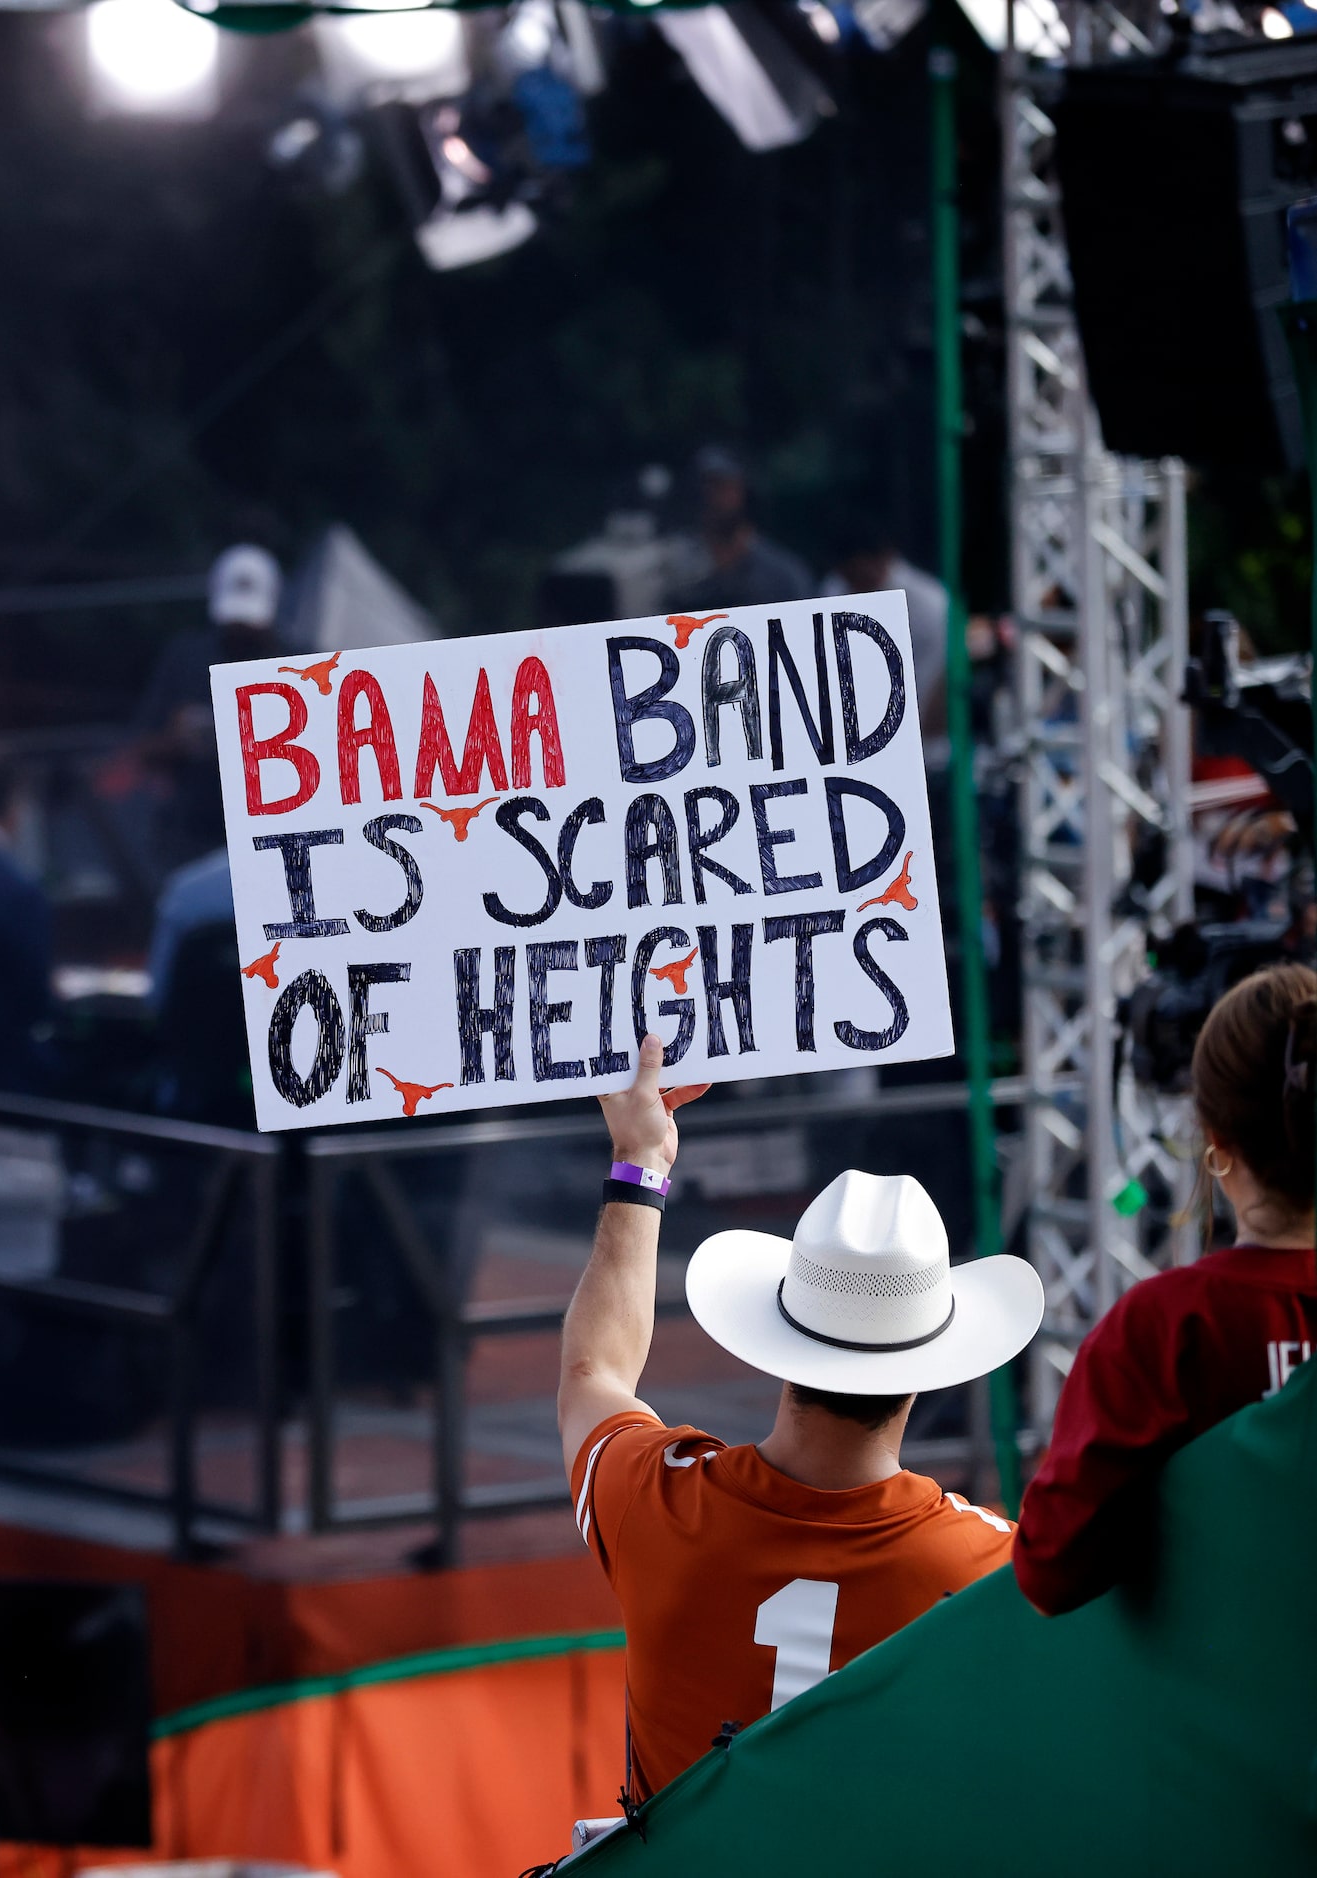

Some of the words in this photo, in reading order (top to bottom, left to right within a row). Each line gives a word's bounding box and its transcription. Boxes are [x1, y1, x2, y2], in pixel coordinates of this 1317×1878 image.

[235, 656, 566, 816] BAMA
[606, 612, 906, 783] BAND
[252, 814, 424, 941] IS
[482, 776, 906, 927] SCARED
[268, 962, 412, 1108] OF
[453, 909, 910, 1086] HEIGHTS
[754, 1578, 839, 1712] 1
